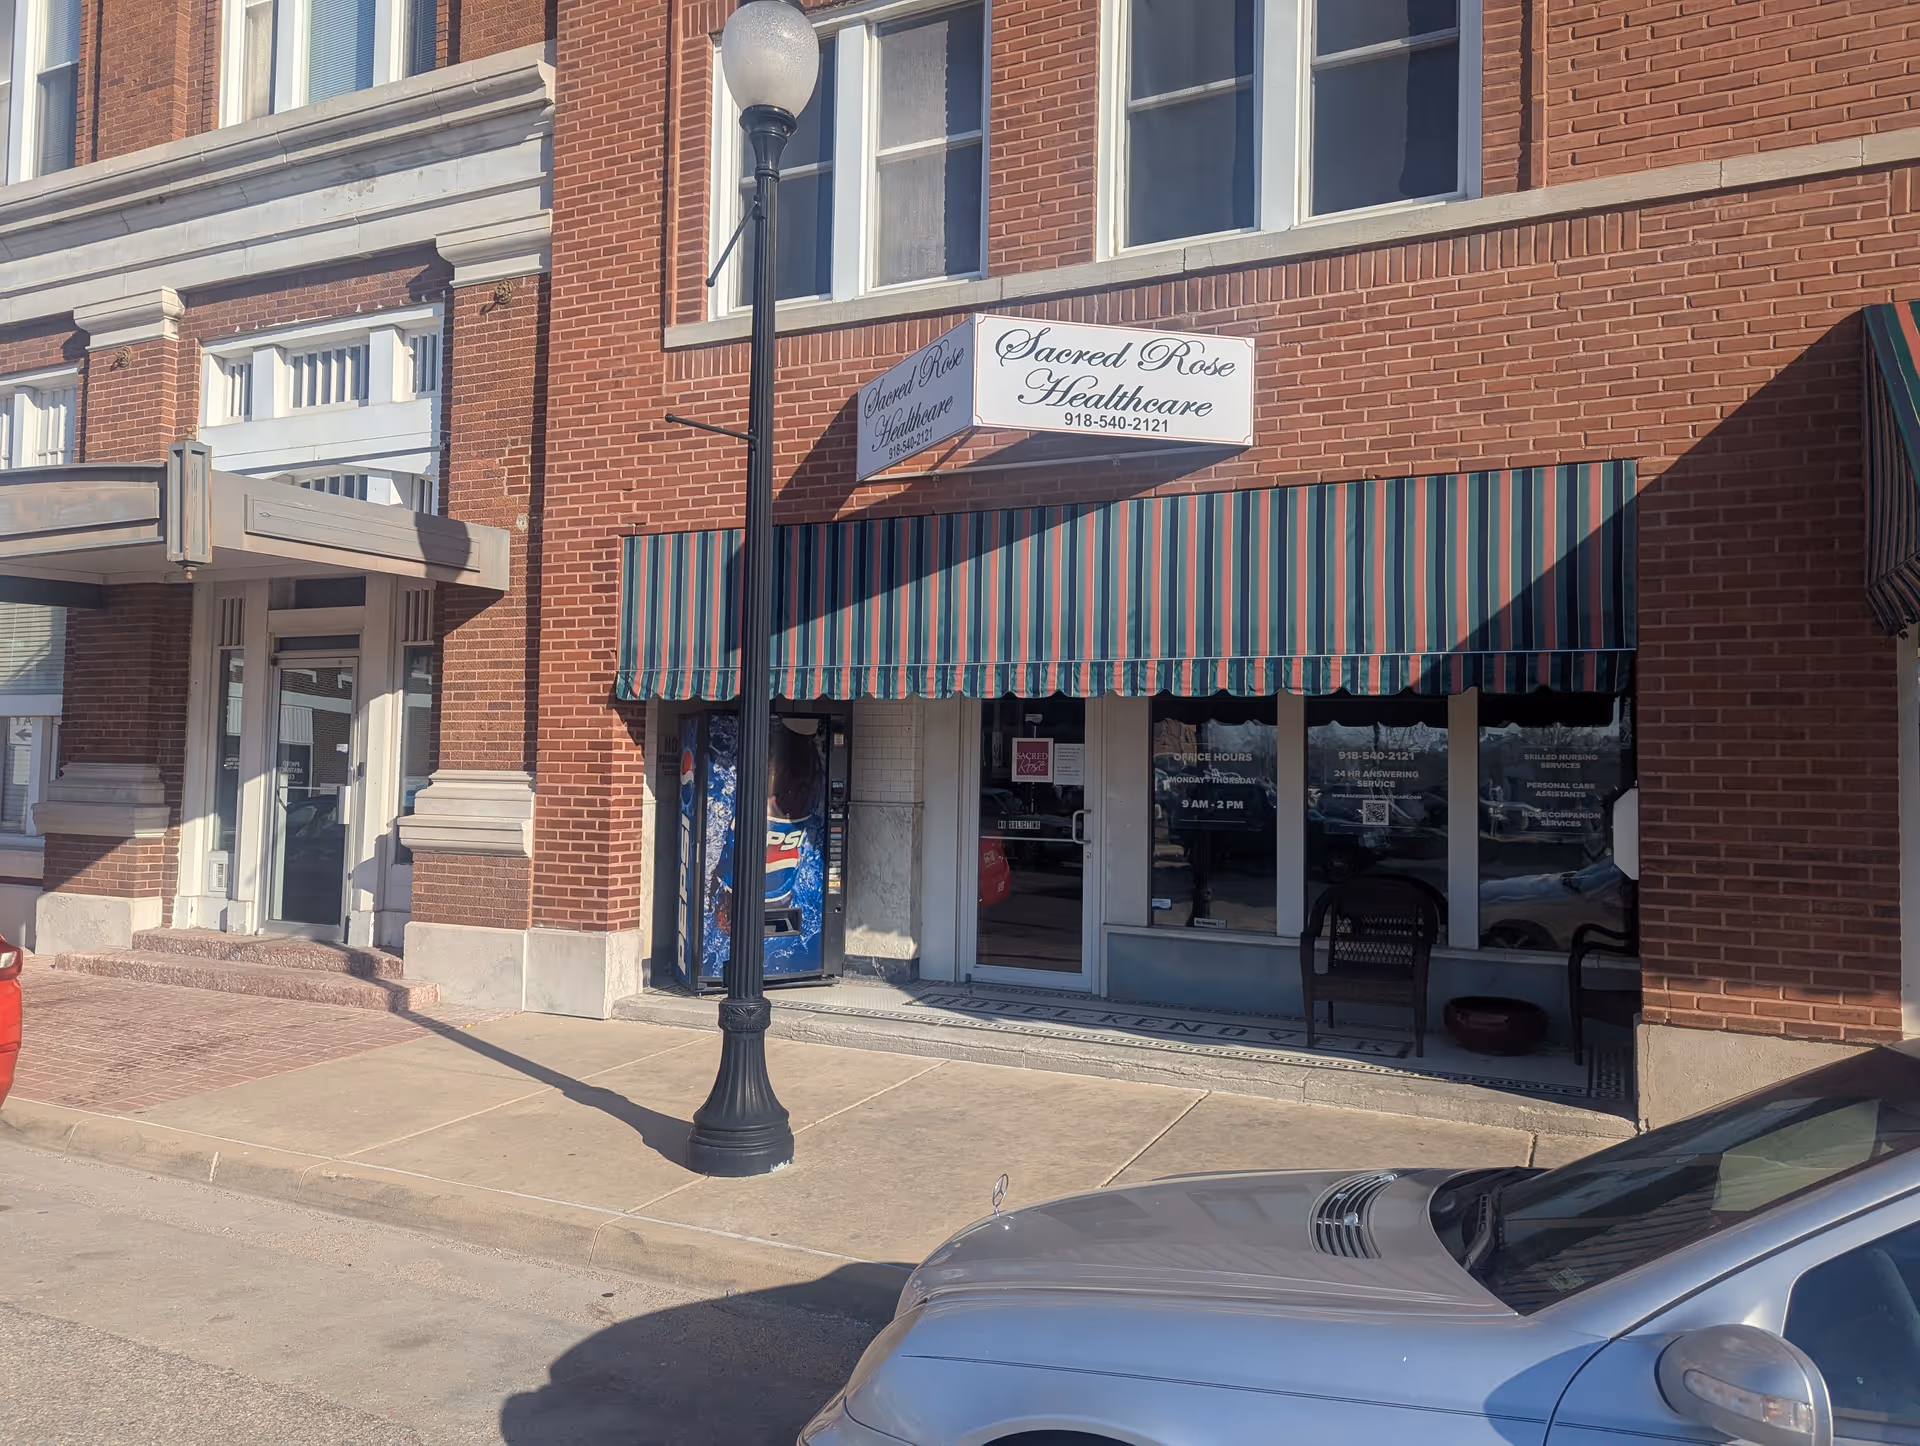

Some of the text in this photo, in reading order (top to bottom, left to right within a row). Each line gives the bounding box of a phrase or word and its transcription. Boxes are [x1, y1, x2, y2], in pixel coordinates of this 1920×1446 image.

[994, 327, 1238, 378] Sacred Rose
[863, 339, 965, 420] Sacred Rose
[1017, 368, 1214, 418] Healthcare
[872, 393, 954, 452] Healthcare
[1064, 412, 1169, 433] 918-540-2121
[888, 427, 933, 461] 918-540-2121
[1016, 752, 1048, 760] SACRED
[1173, 752, 1253, 762] OFFICE HOURS
[1338, 751, 1415, 761] 918-540-2121
[1347, 770, 1361, 778] HR
[1362, 770, 1419, 778] ANSWERING
[1212, 777, 1257, 785] THURSDAY
[1357, 780, 1396, 788] SERVICE
[1181, 800, 1189, 808] 9
[1191, 800, 1209, 808] AM
[1216, 800, 1224, 809] 2
[1226, 800, 1244, 809] PM
[1521, 810, 1601, 819] HOME COMPANION
[677, 812, 690, 976] PEPSI
